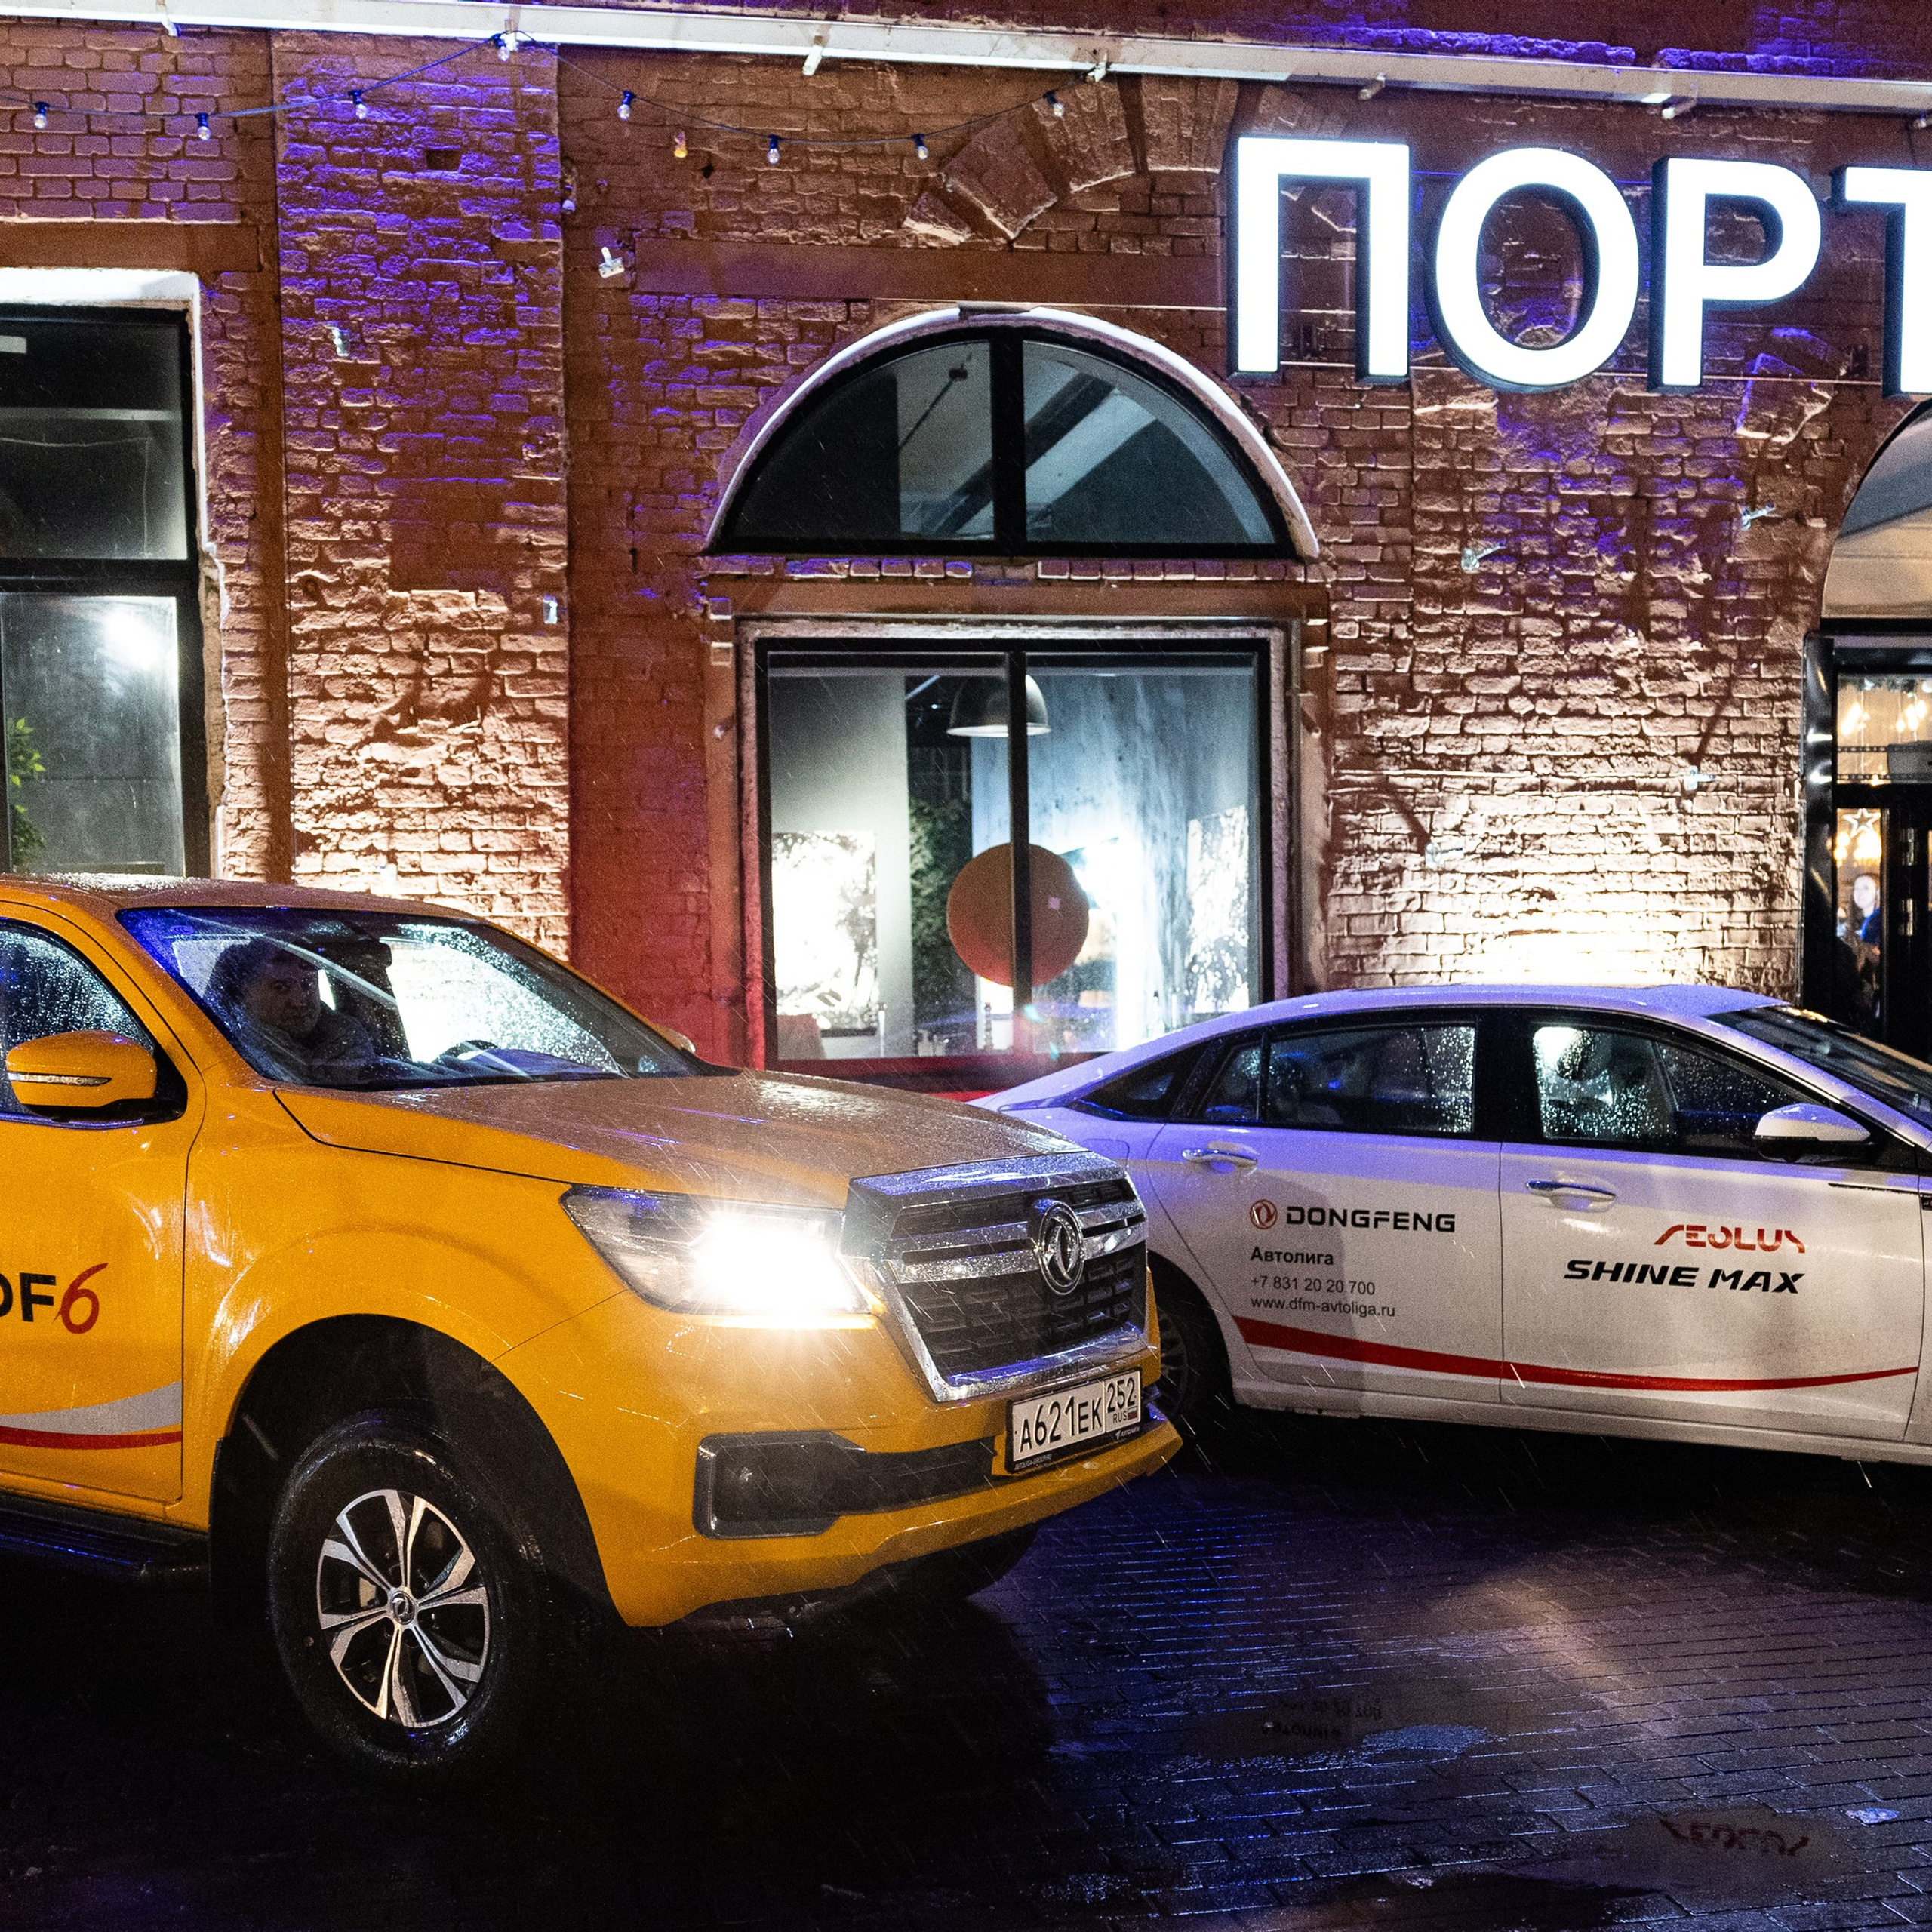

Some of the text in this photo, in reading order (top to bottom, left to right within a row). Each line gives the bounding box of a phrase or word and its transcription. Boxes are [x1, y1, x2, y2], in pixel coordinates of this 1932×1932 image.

[1286, 1206, 1456, 1233] DONGFENG
[1250, 1246, 1334, 1266] Автолига
[1251, 1275, 1376, 1295] +7 831 20 20 700
[1563, 1259, 1805, 1294] SHINE MAX
[1251, 1296, 1395, 1318] www.dfm-avtoliga.ru
[1106, 1377, 1136, 1414] 252
[1112, 1410, 1128, 1424] RUS
